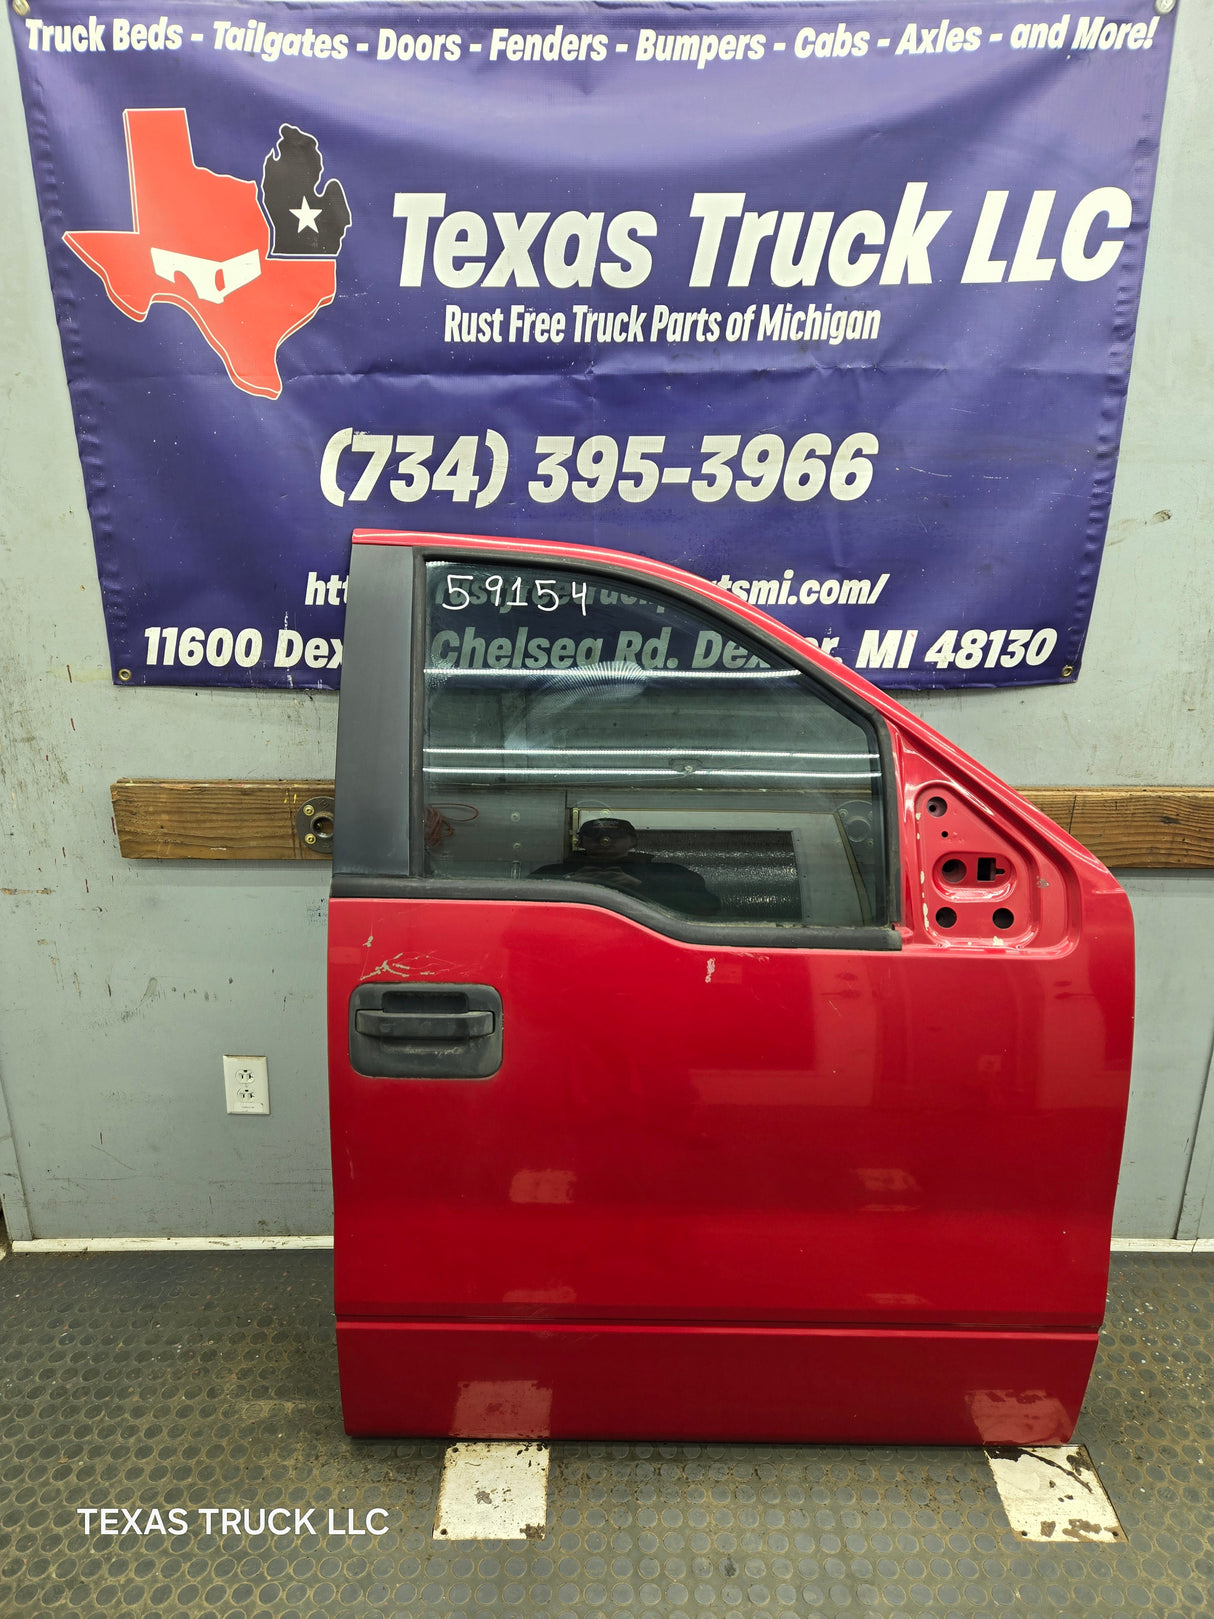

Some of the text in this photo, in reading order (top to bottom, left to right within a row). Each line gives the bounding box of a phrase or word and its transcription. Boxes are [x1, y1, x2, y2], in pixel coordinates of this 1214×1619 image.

[26, 16, 105, 52] Truck
[112, 16, 183, 51] Beds
[213, 19, 349, 62] Tailgates
[376, 28, 462, 61] Doors
[489, 25, 608, 61] Fenders
[635, 28, 767, 69] Bumpers
[794, 23, 870, 58] Cabs
[894, 19, 982, 55] Axles
[1010, 14, 1070, 49] and
[1072, 16, 1160, 50] More!
[393, 182, 1133, 289] Texas Truck LLC
[444, 304, 882, 346] Rust Free Truck Parts of Michigan
[320, 427, 879, 508] (734) 395-3966
[442, 574, 588, 617] 59154
[144, 626, 263, 668] 11600
[431, 627, 603, 669] Chelsea
[613, 627, 679, 669] Rd.
[855, 629, 918, 669] MI
[924, 627, 1058, 668] 48130
